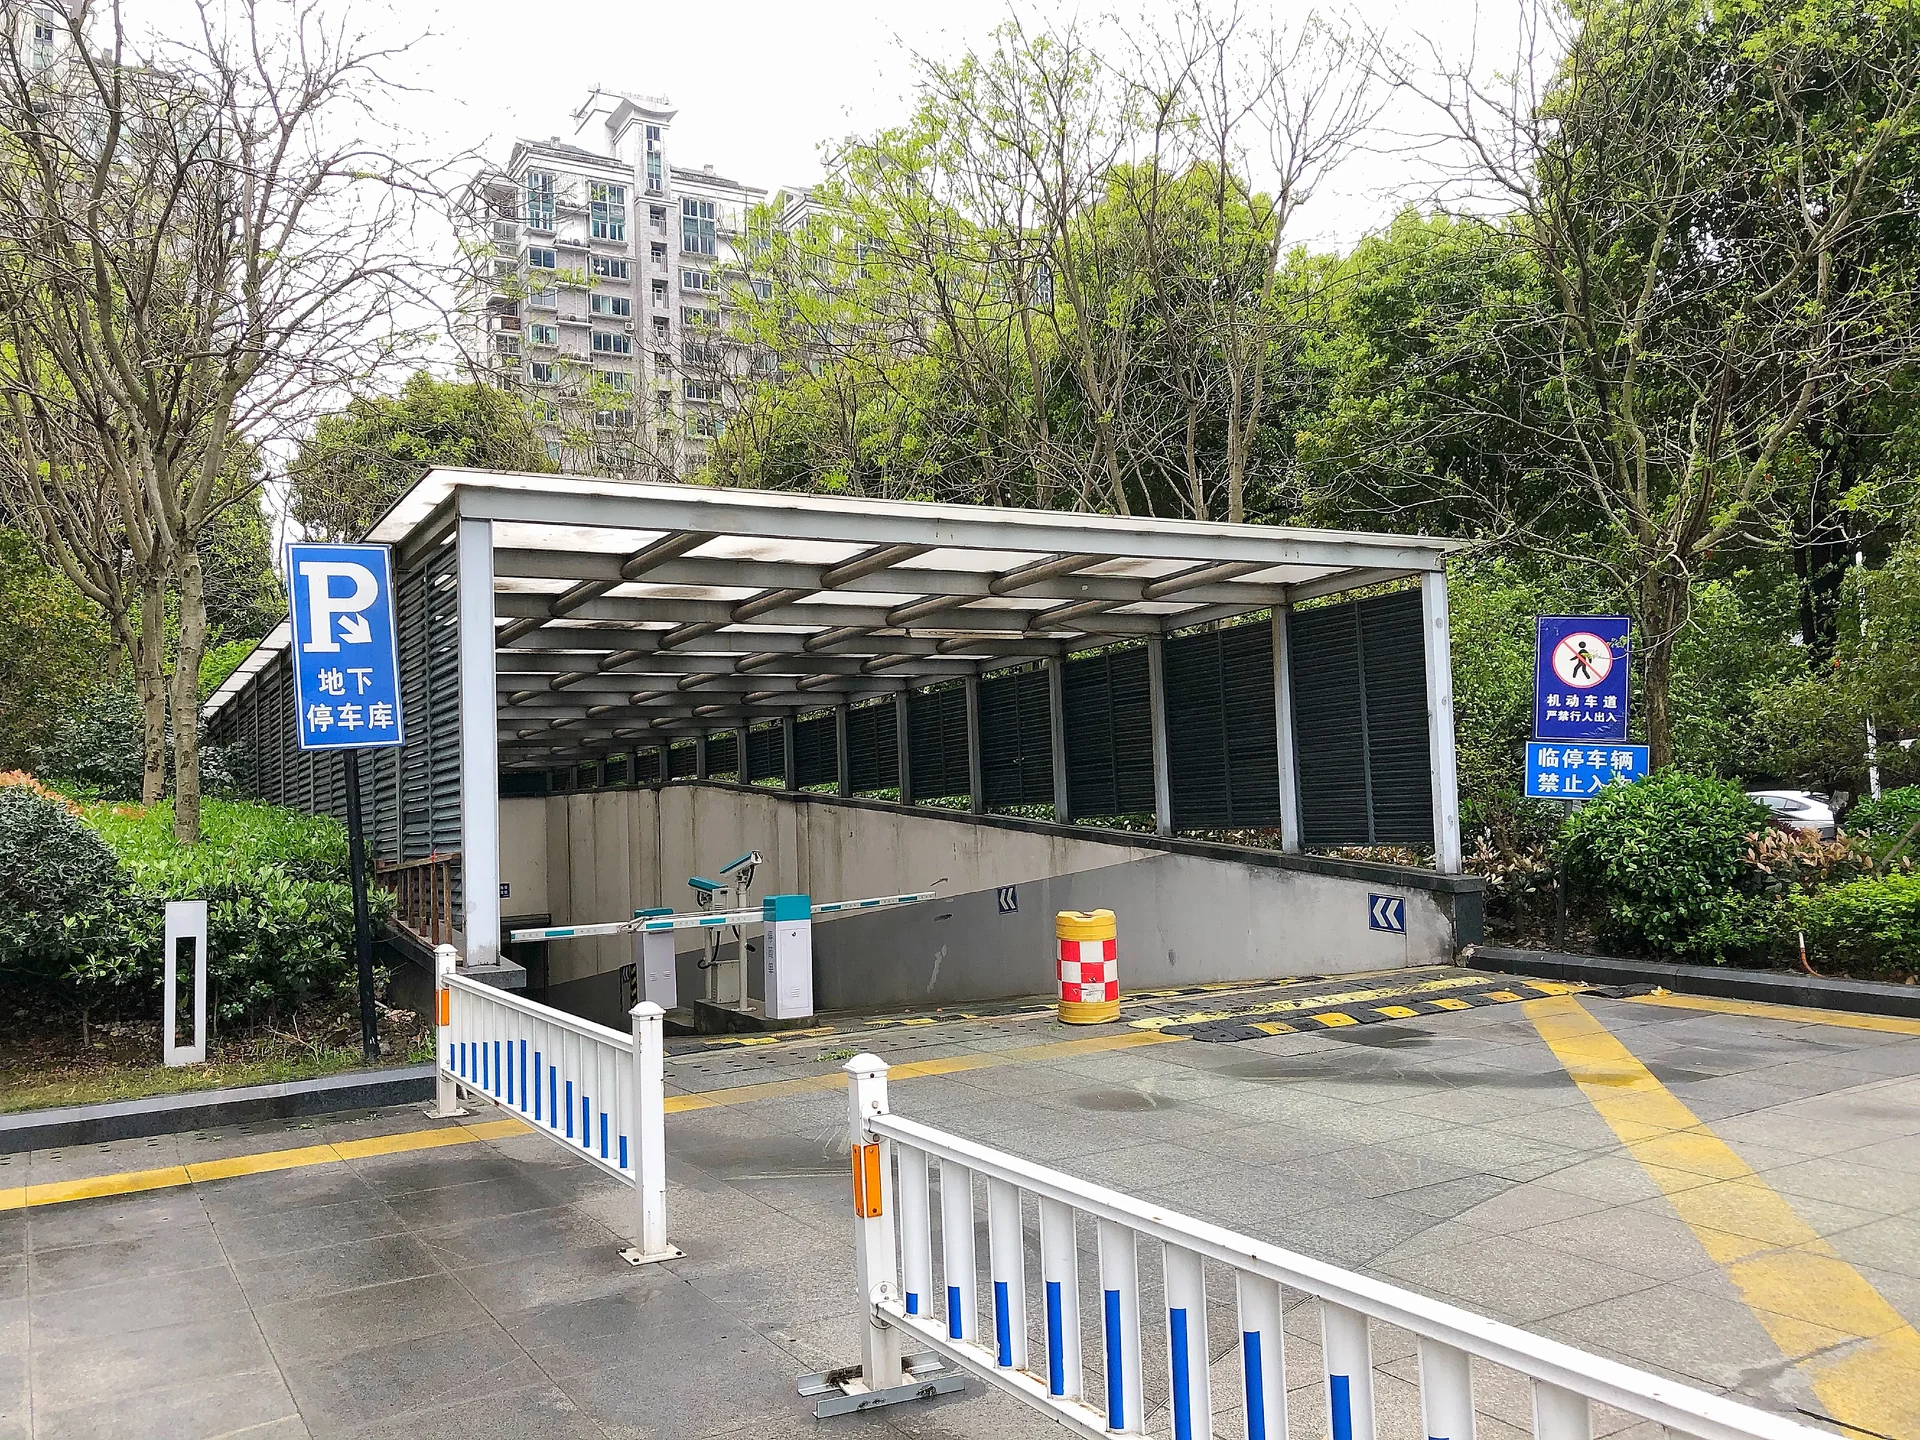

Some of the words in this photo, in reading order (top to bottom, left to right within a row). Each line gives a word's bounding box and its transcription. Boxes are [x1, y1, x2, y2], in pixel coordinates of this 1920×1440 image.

[299, 561, 379, 653] P
[317, 667, 374, 696] 地下
[1546, 693, 1618, 709] 机动车道
[306, 701, 395, 733] 停车库
[1545, 710, 1618, 723] 严禁行人出入
[1537, 747, 1634, 771] 临停车辆
